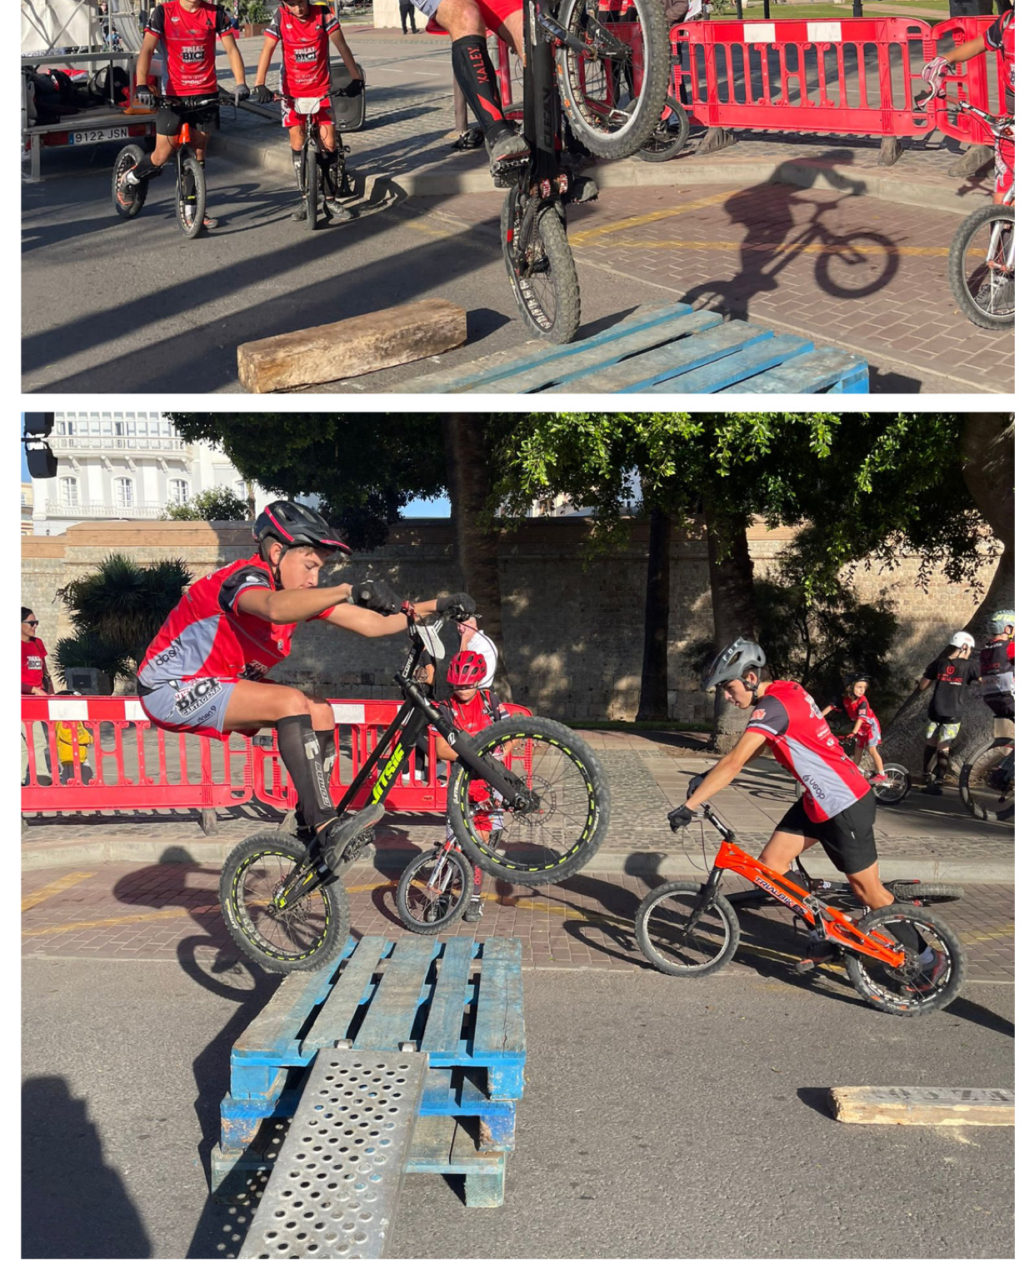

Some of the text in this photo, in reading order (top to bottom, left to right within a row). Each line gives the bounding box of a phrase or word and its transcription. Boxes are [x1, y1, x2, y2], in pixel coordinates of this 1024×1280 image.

[182, 52, 205, 61] BICI
[75, 127, 127, 142] 9122 JSN
[174, 677, 219, 712] BICI
